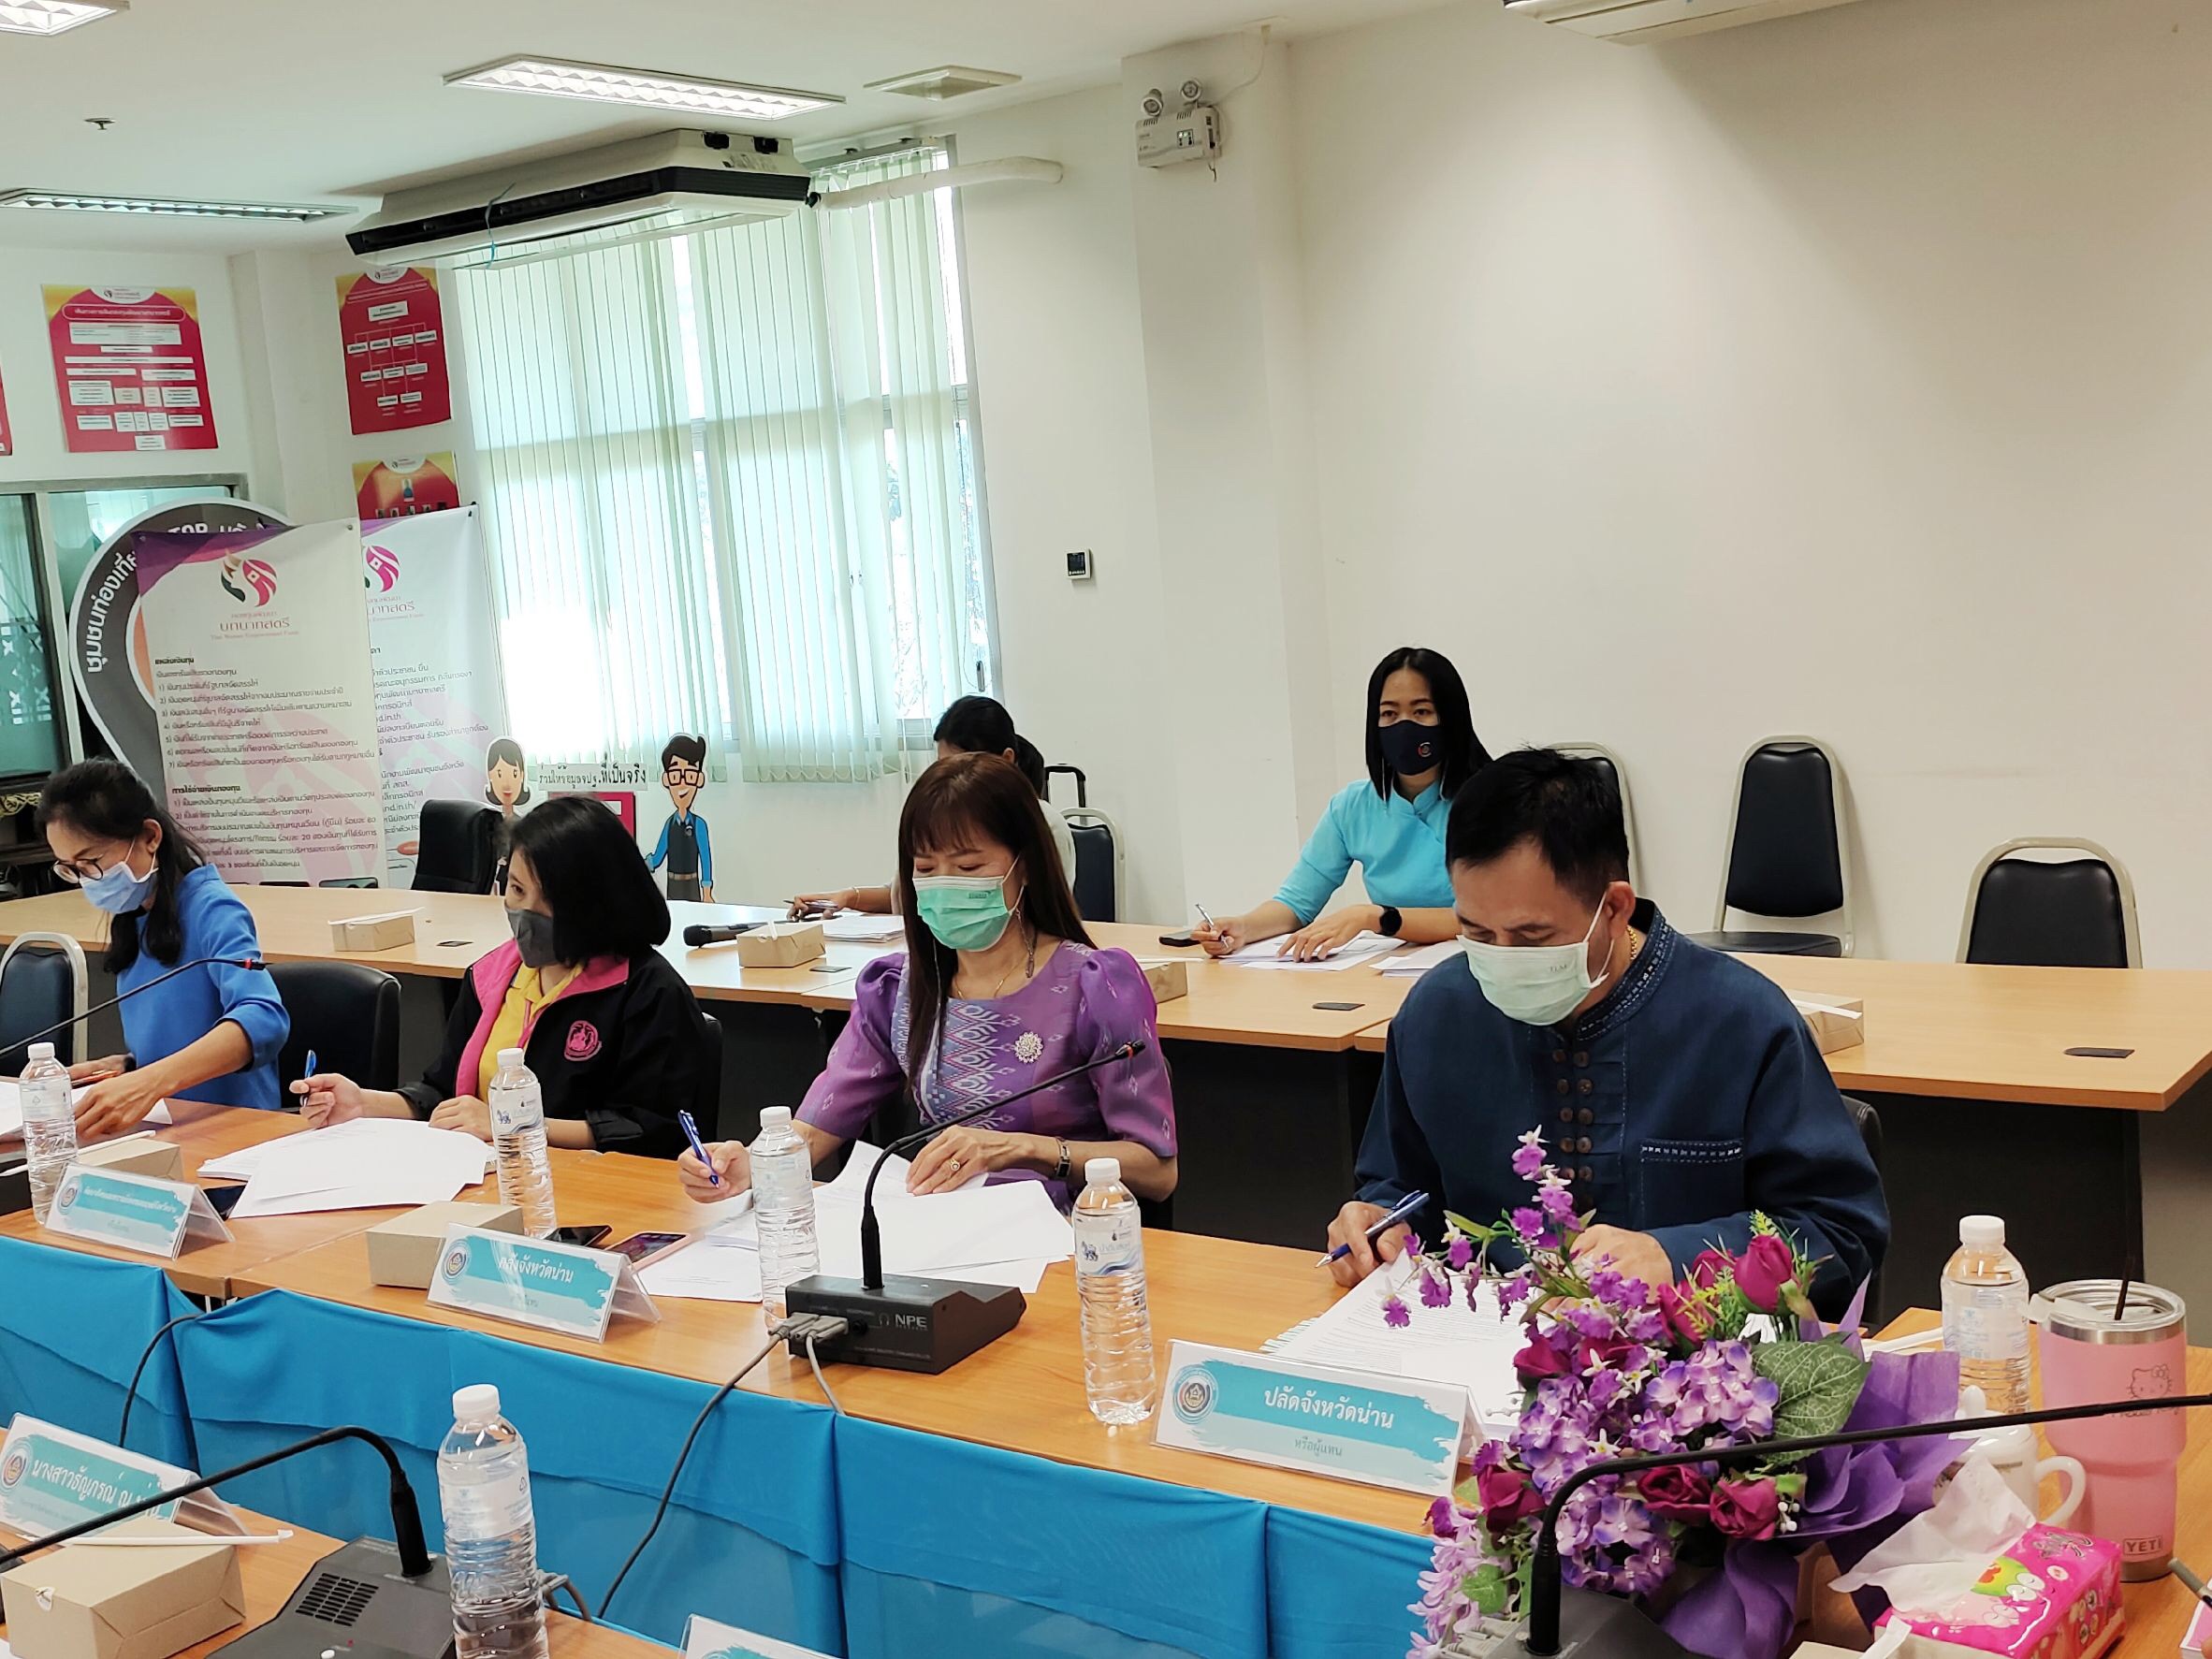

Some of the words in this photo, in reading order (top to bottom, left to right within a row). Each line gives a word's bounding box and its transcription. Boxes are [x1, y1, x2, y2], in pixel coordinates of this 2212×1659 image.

[895, 1313, 927, 1328] NPE
[1264, 1385, 1394, 1429] ปลัดจังหวัดน่าน
[2125, 1537, 2162, 1553] YETI
